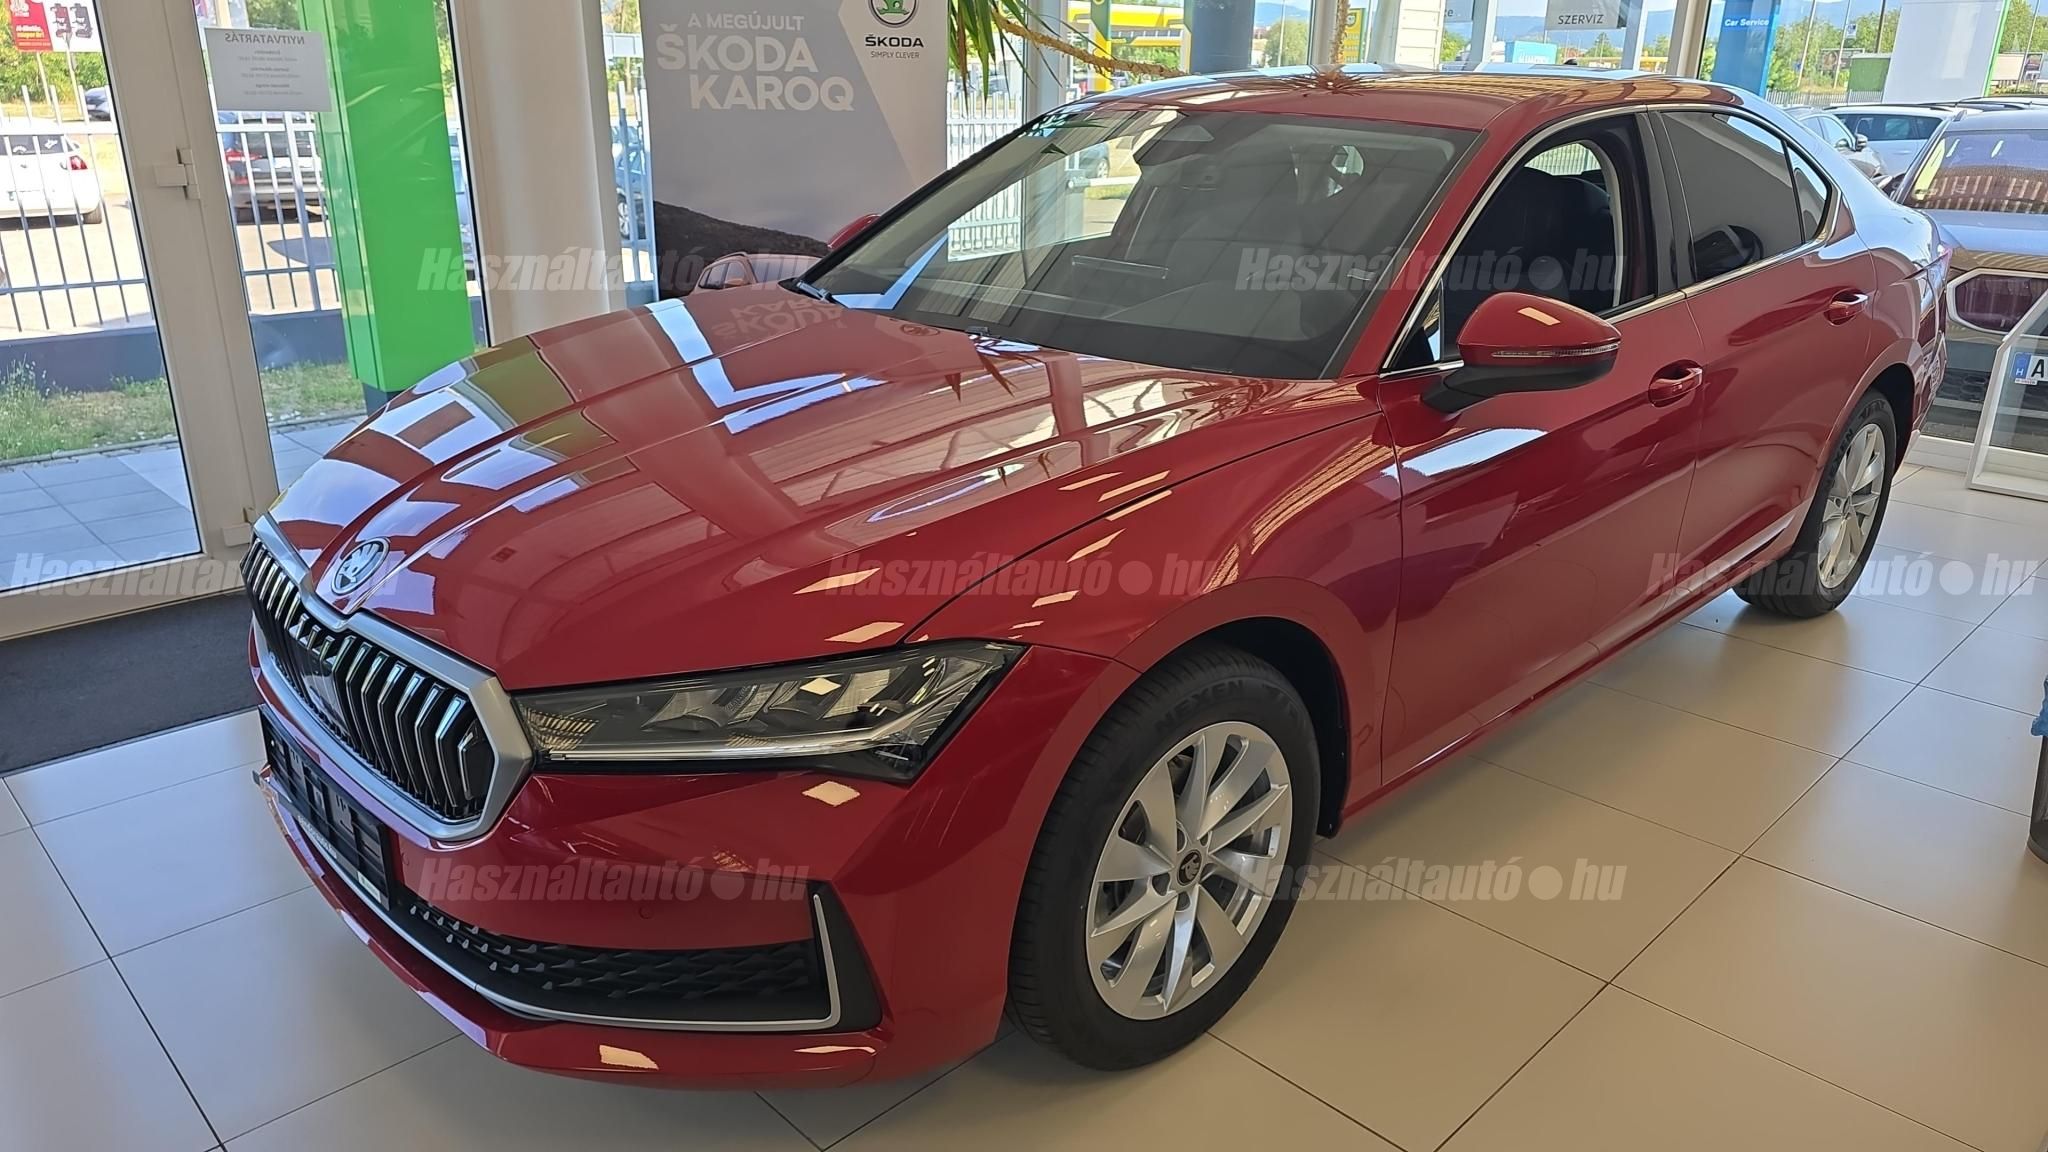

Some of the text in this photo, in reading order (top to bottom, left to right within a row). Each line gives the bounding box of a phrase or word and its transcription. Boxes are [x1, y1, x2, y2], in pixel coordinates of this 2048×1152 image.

[687, 11, 805, 31] A MEGÚJULT
[1558, 14, 1605, 25] SZERVIZ
[1740, 18, 1770, 26] Service
[655, 23, 819, 73] ŠKODA
[865, 34, 925, 48] ŠKODA
[870, 51, 920, 60] SIMPLY CLEVER
[689, 74, 855, 111] KAROQ
[2031, 358, 2045, 378] A
